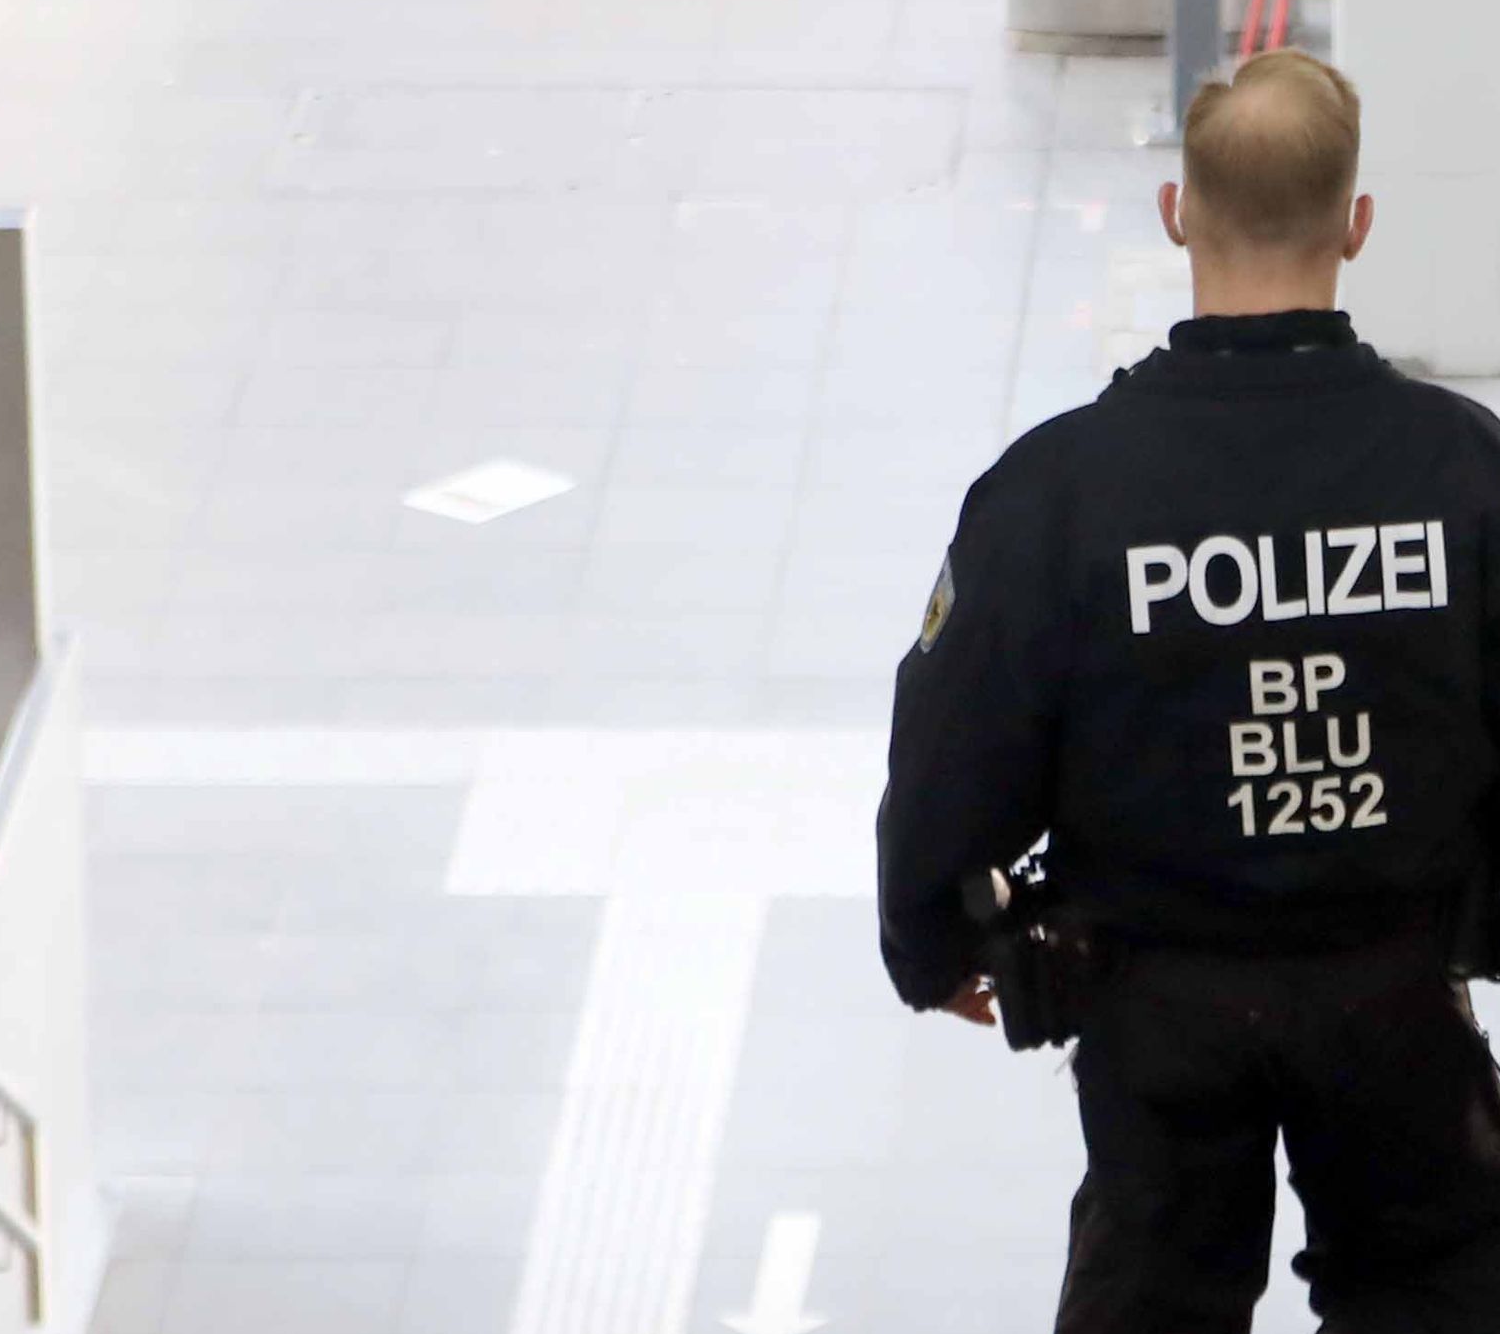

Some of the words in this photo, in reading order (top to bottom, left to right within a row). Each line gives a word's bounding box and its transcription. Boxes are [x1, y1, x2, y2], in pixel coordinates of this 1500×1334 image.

[1125, 520, 1449, 635] POLIZEI
[1248, 652, 1347, 716] BP
[1228, 711, 1372, 777] BLU
[1227, 772, 1388, 837] 1252
